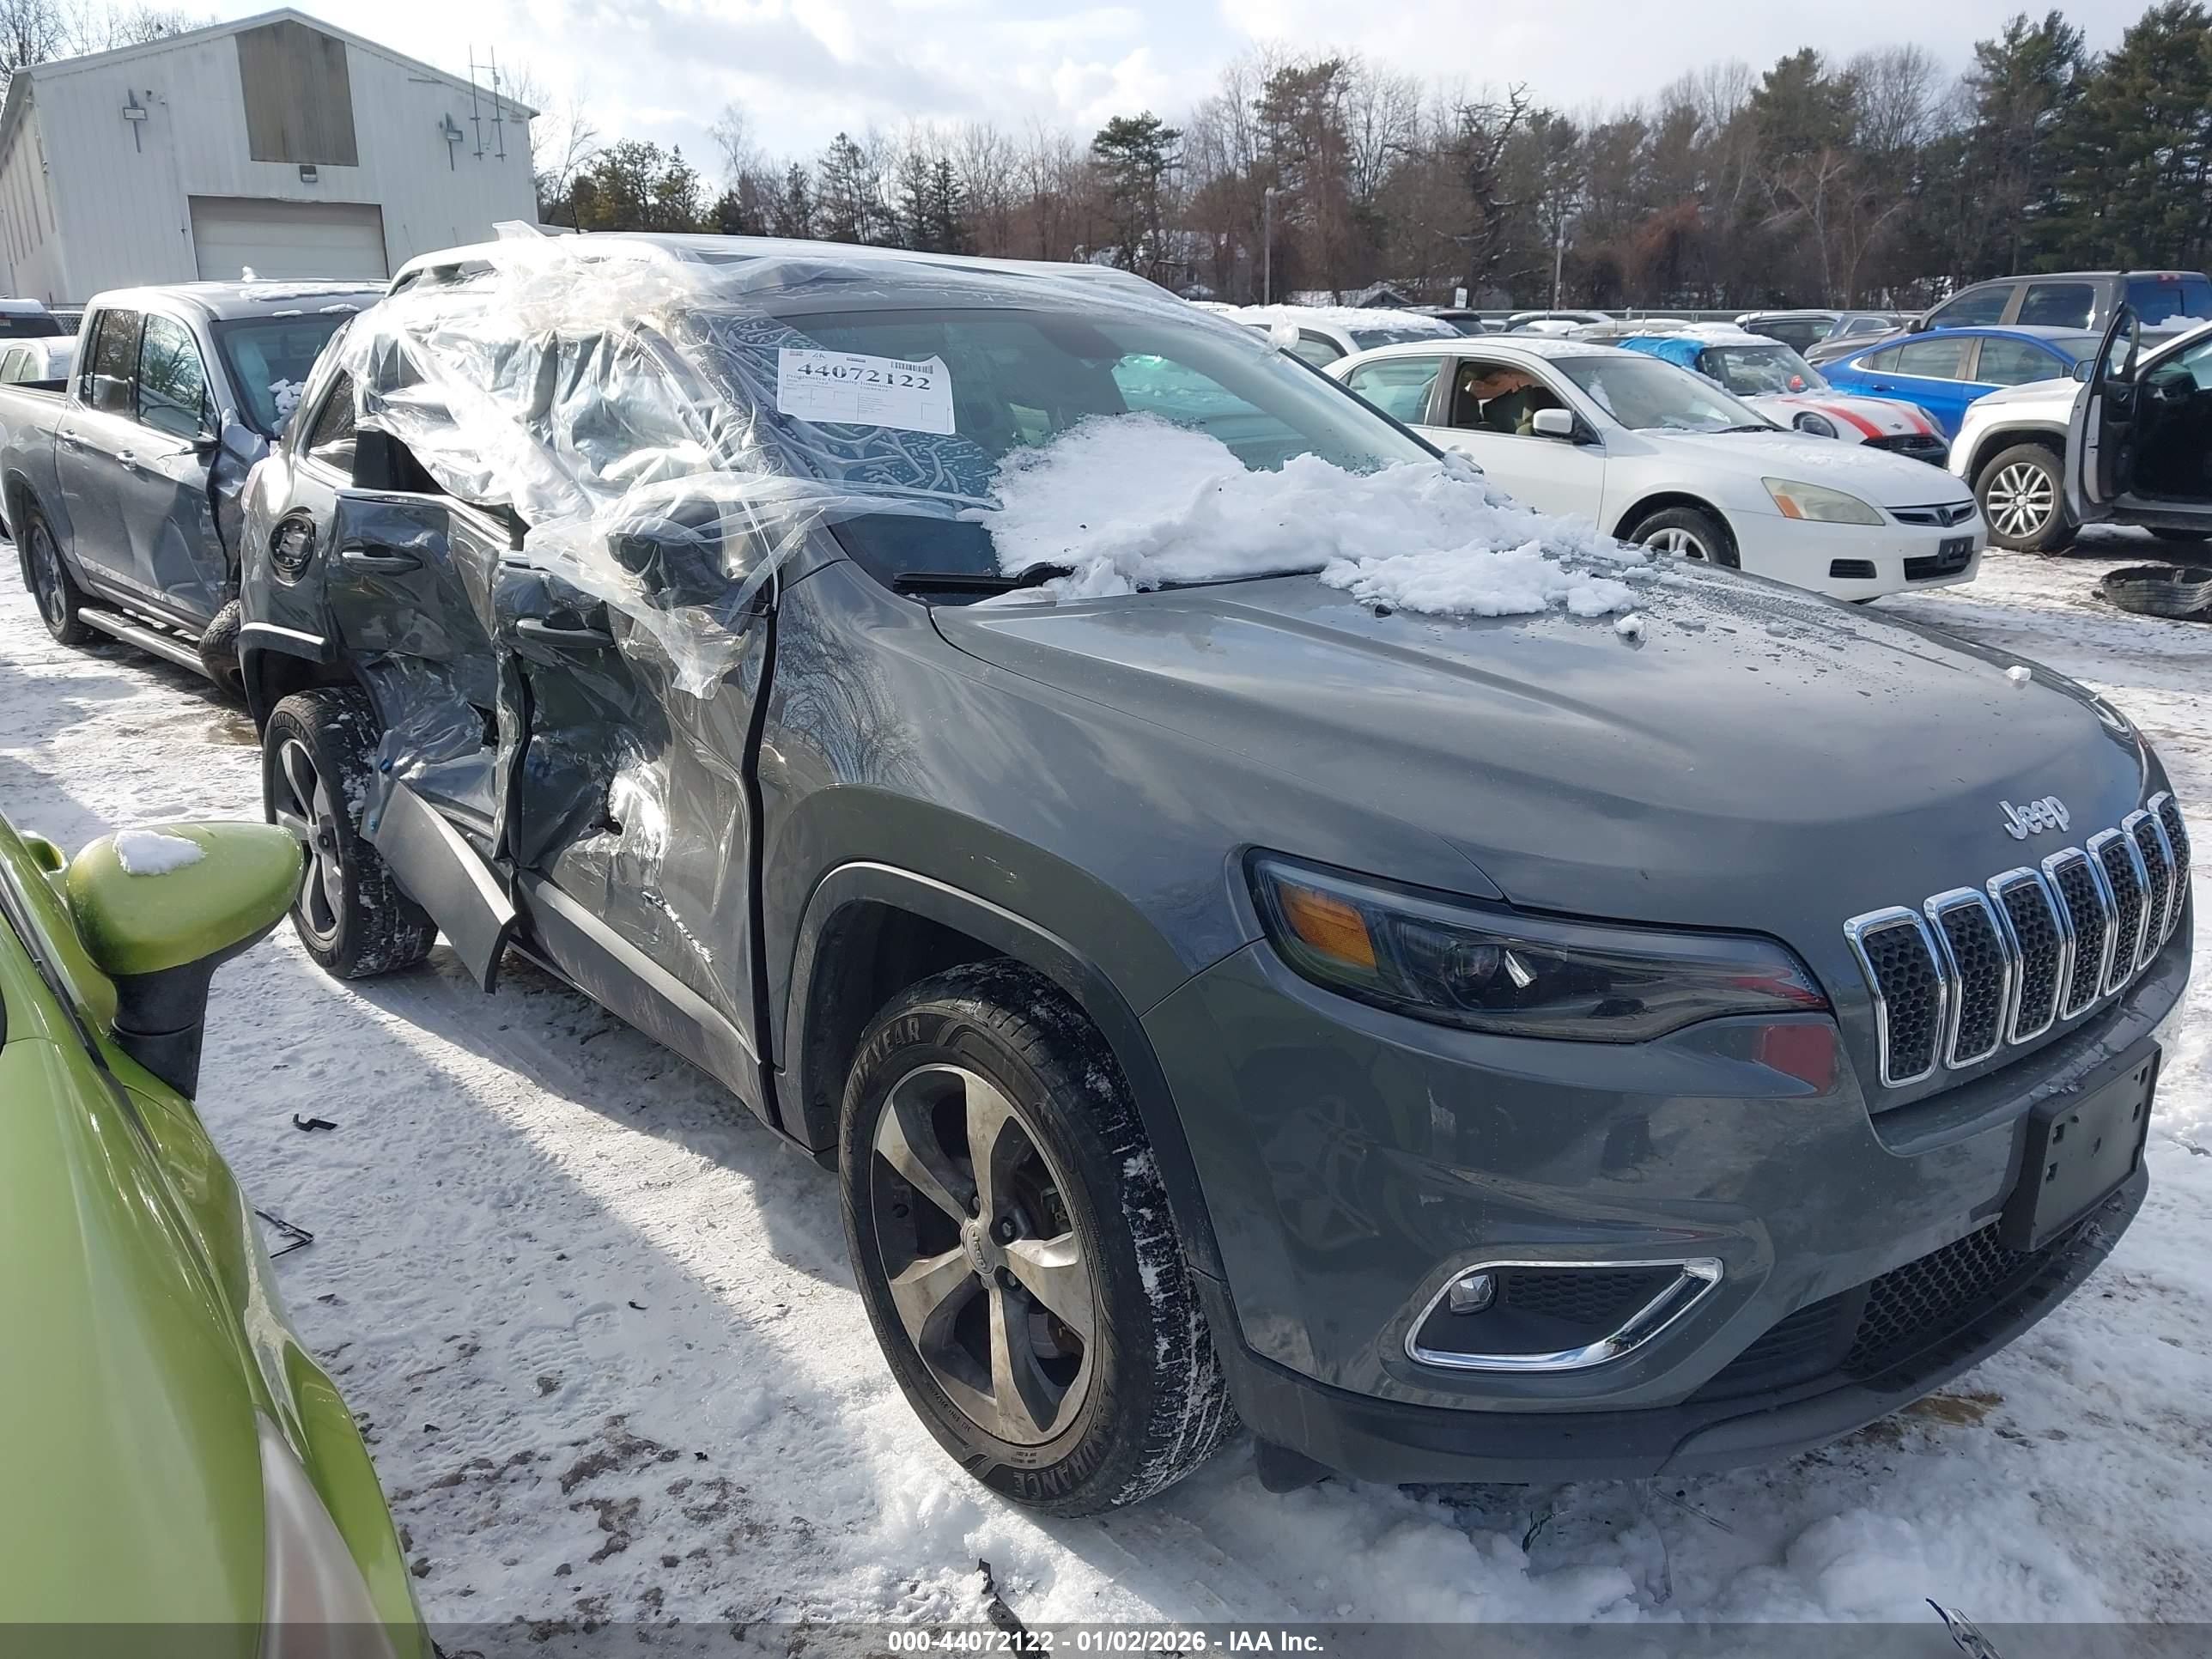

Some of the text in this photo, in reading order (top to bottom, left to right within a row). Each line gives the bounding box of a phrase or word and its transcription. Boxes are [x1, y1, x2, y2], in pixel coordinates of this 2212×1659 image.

[797, 362, 931, 390] 44072122
[1997, 795, 2070, 840] Jeep
[971, 1228, 987, 1269] Jeep
